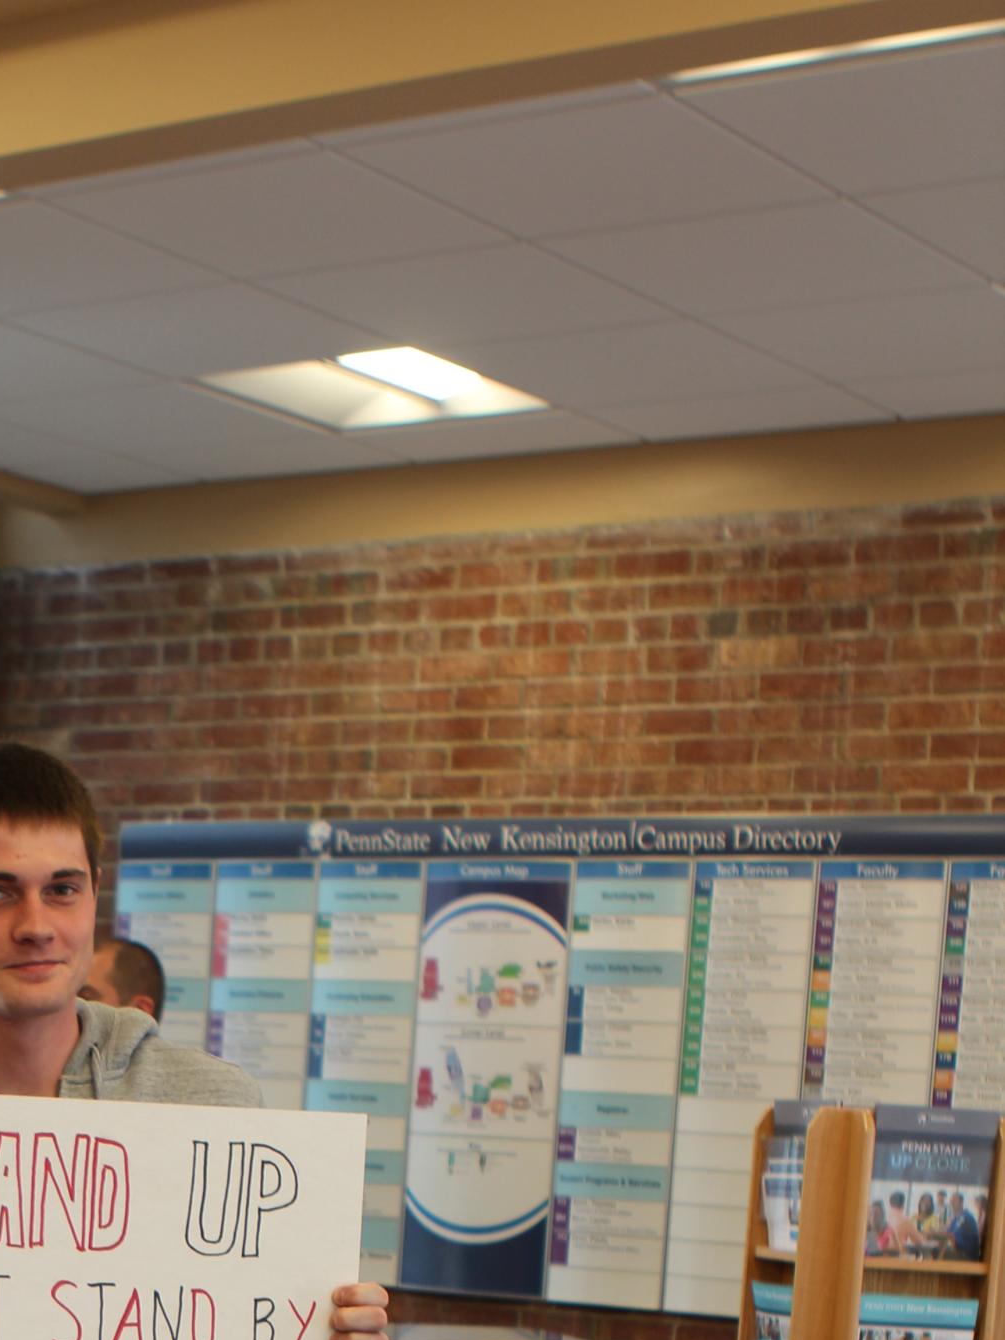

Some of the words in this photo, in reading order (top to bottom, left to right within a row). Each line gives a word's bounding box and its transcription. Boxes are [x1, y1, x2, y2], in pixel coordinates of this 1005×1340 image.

[335, 827, 431, 852] PennState
[442, 825, 491, 851] New
[733, 824, 842, 855] Directory
[460, 864, 501, 878] Campus
[505, 864, 529, 879] Map
[617, 863, 643, 876] Staff
[716, 863, 739, 876] Tech
[743, 863, 789, 877] Services
[857, 864, 899, 878] Faculty
[902, 1141, 931, 1153] PENN
[933, 1143, 963, 1156] STATE
[890, 1152, 913, 1169] UP
[185, 1140, 298, 1258] UP
